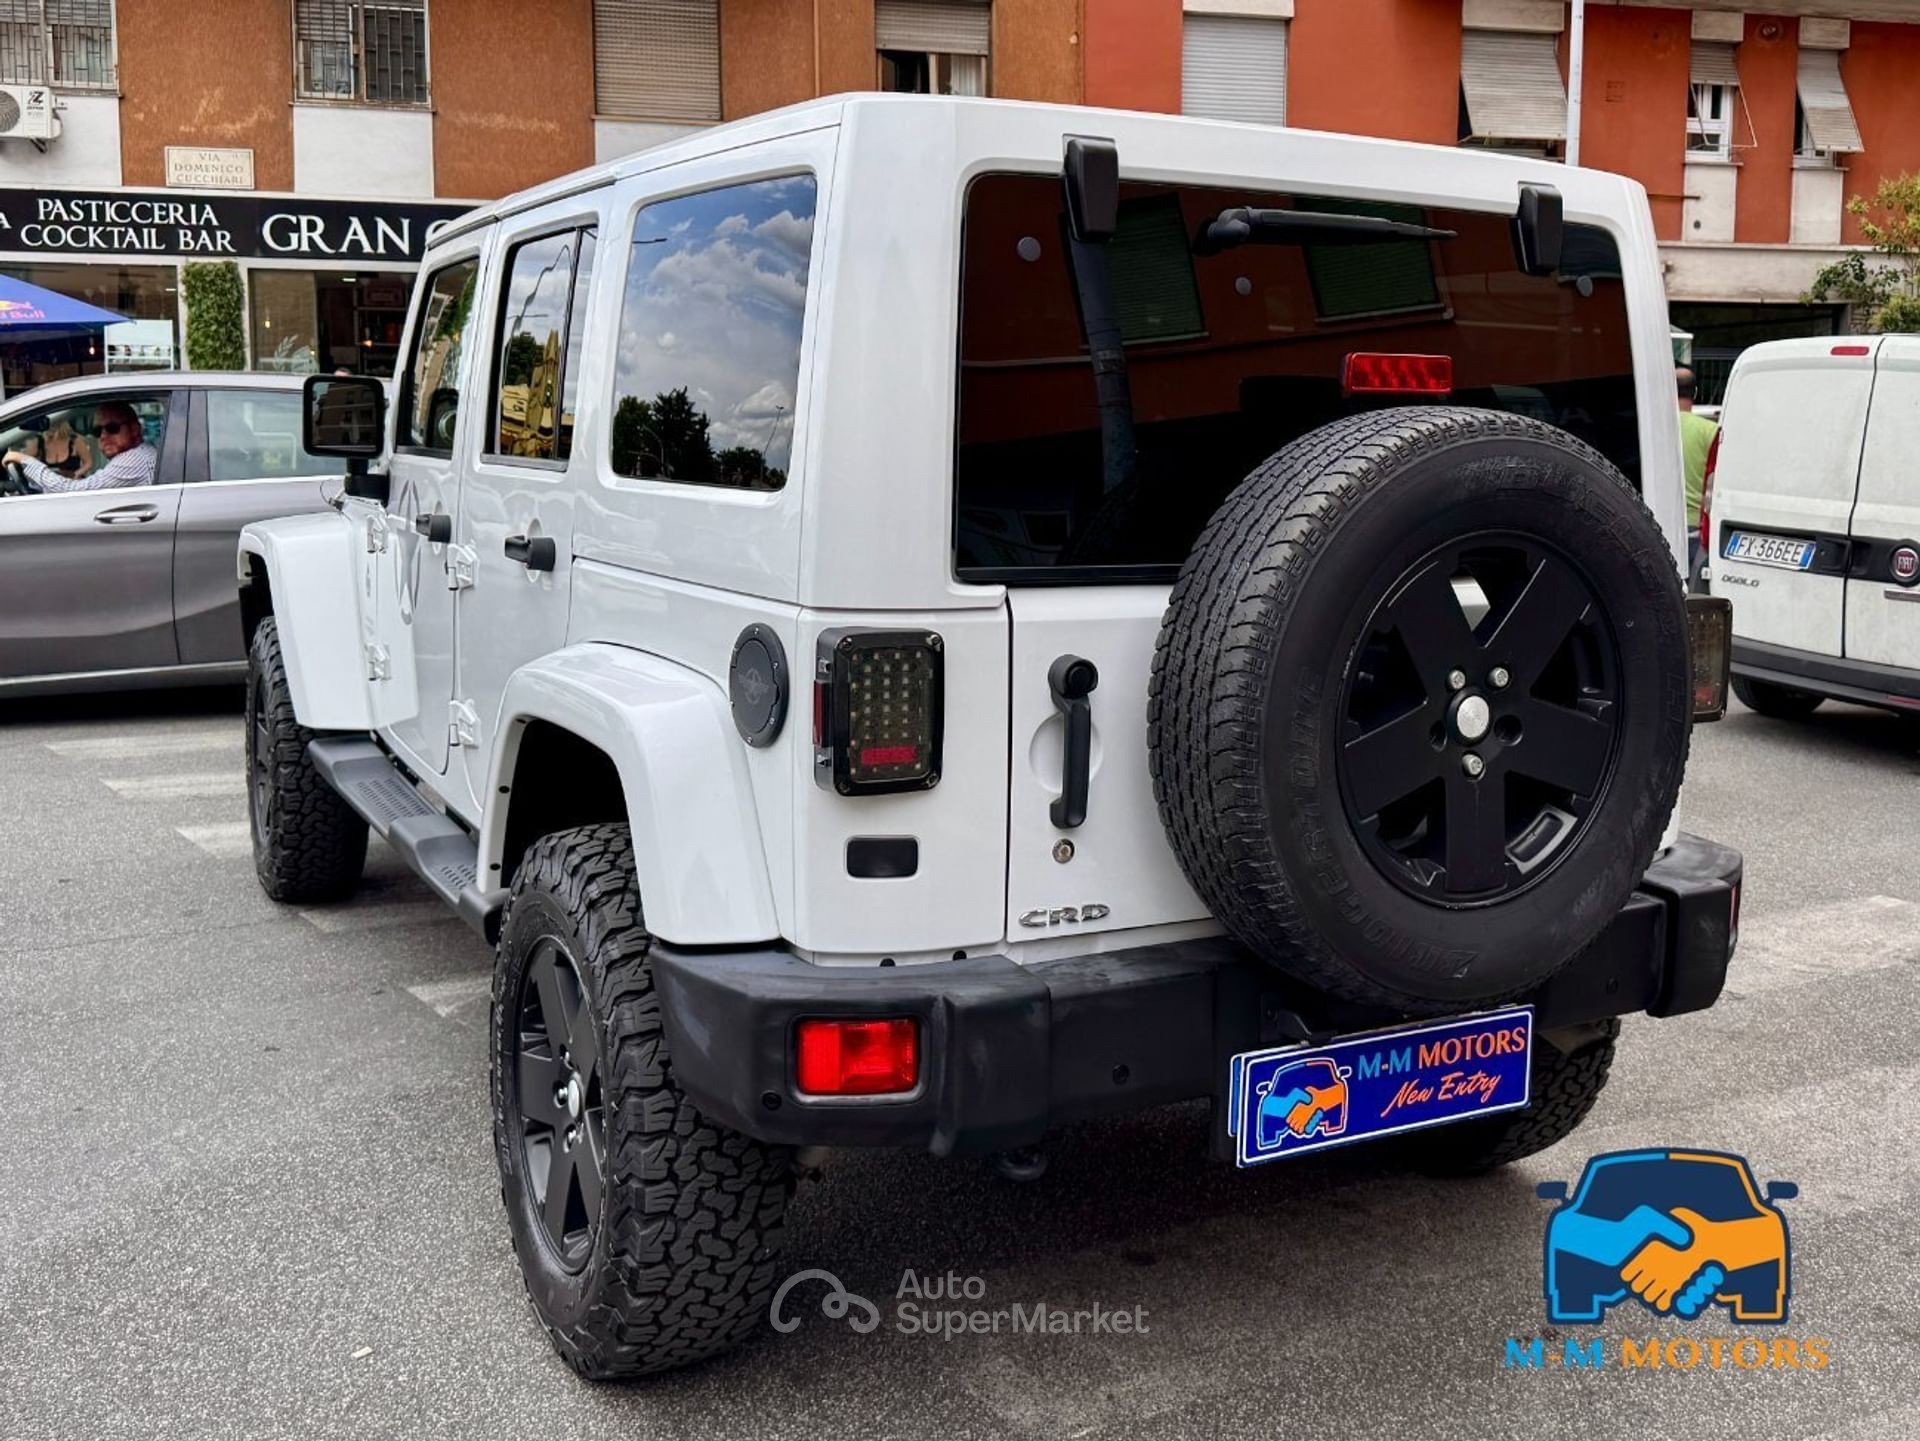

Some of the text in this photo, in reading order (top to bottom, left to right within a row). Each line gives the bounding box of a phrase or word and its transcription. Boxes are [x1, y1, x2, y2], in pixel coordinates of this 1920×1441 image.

[174, 163, 244, 174] DOMENICO
[199, 152, 221, 162] VIA
[176, 174, 243, 185] CUCCHIARI
[38, 198, 219, 226] PASTICCERIA
[20, 224, 238, 252] COCKTAIL BAR
[262, 214, 411, 256] GRAN
[1019, 903, 1110, 927] CRD
[1357, 1026, 1527, 1081] M-M MOTORS
[1381, 1072, 1502, 1119] New Entry
